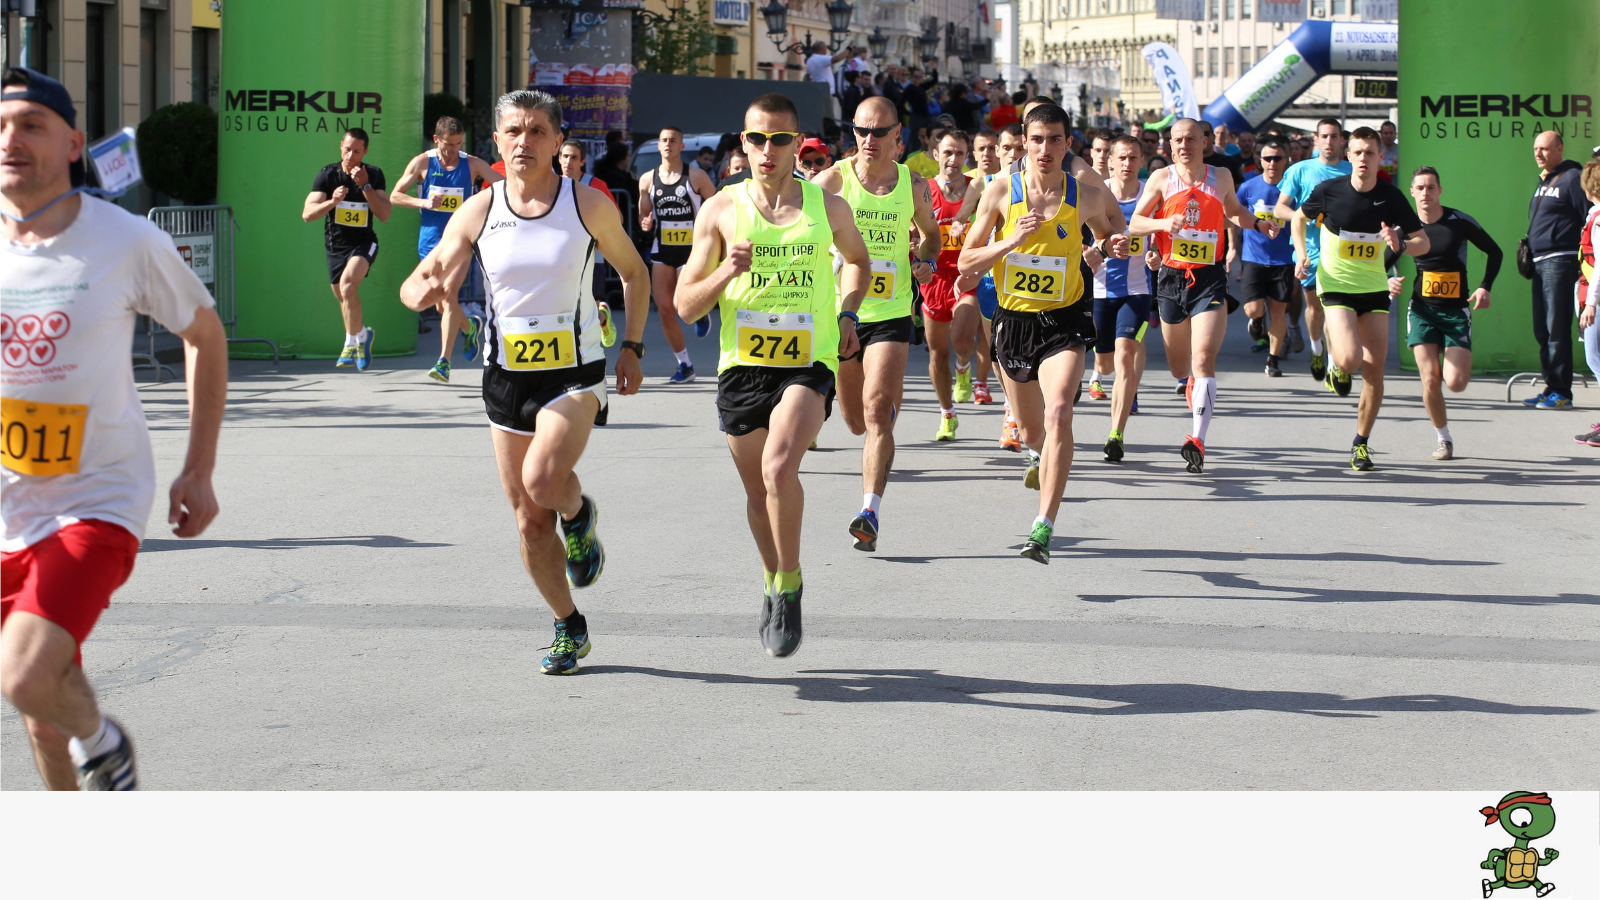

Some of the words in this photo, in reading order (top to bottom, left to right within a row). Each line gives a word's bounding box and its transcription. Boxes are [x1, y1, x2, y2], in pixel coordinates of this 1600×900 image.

[715, 1, 742, 20] HOTEL
[1355, 49, 1377, 62] APRIL
[225, 90, 383, 114] MERKUR
[1420, 94, 1592, 118] MERKUR
[224, 115, 382, 134] OSIGURANJE
[1419, 121, 1592, 139] OSIGURANJE
[441, 198, 457, 209] 49
[344, 211, 360, 223] 34
[499, 220, 517, 228] asics
[666, 231, 688, 242] 117
[869, 229, 897, 243] VAIS
[1179, 243, 1207, 260] 351
[1347, 244, 1375, 259] 119
[777, 269, 814, 287] VAIS
[871, 276, 886, 294] 5
[1013, 271, 1055, 295] 282
[782, 291, 809, 300] ЦИРКУЗ
[1424, 280, 1459, 295] 2007
[513, 337, 560, 364] 221
[749, 334, 800, 360] 274
[0, 421, 72, 463] 011
